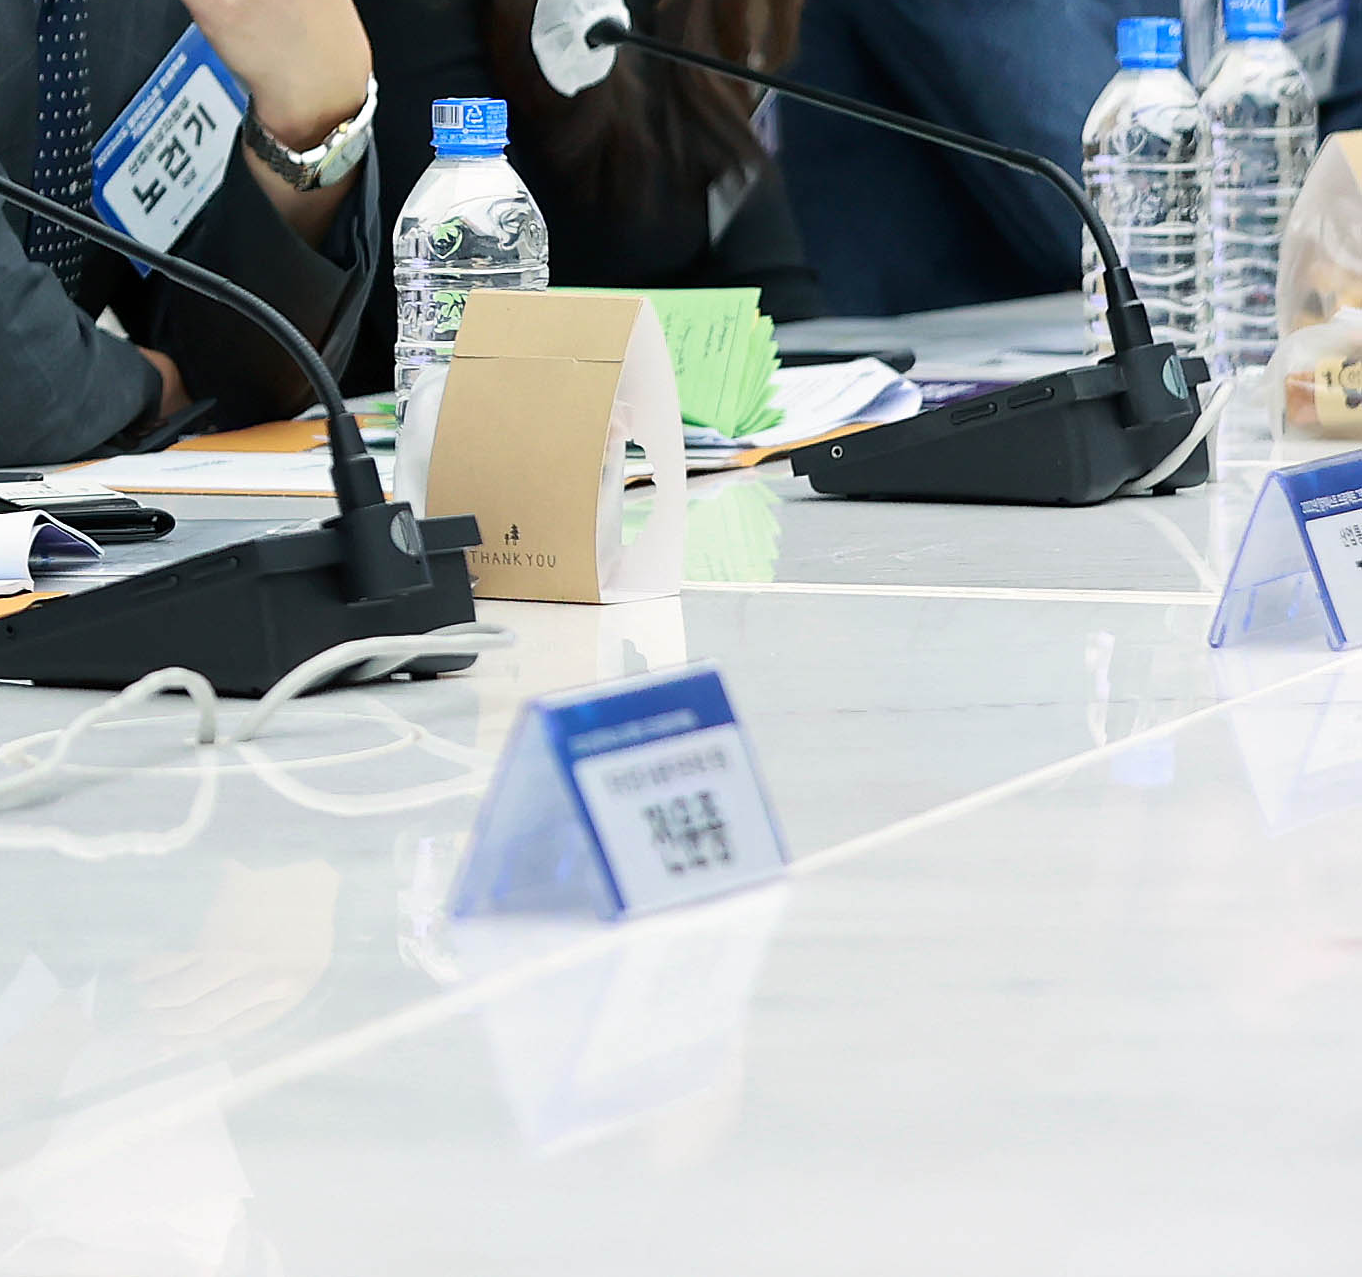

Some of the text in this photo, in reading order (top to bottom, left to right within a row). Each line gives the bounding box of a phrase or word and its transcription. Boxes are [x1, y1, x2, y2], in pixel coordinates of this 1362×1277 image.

[132, 102, 217, 215] 노건기
[470, 550, 556, 568] THANK YOU
